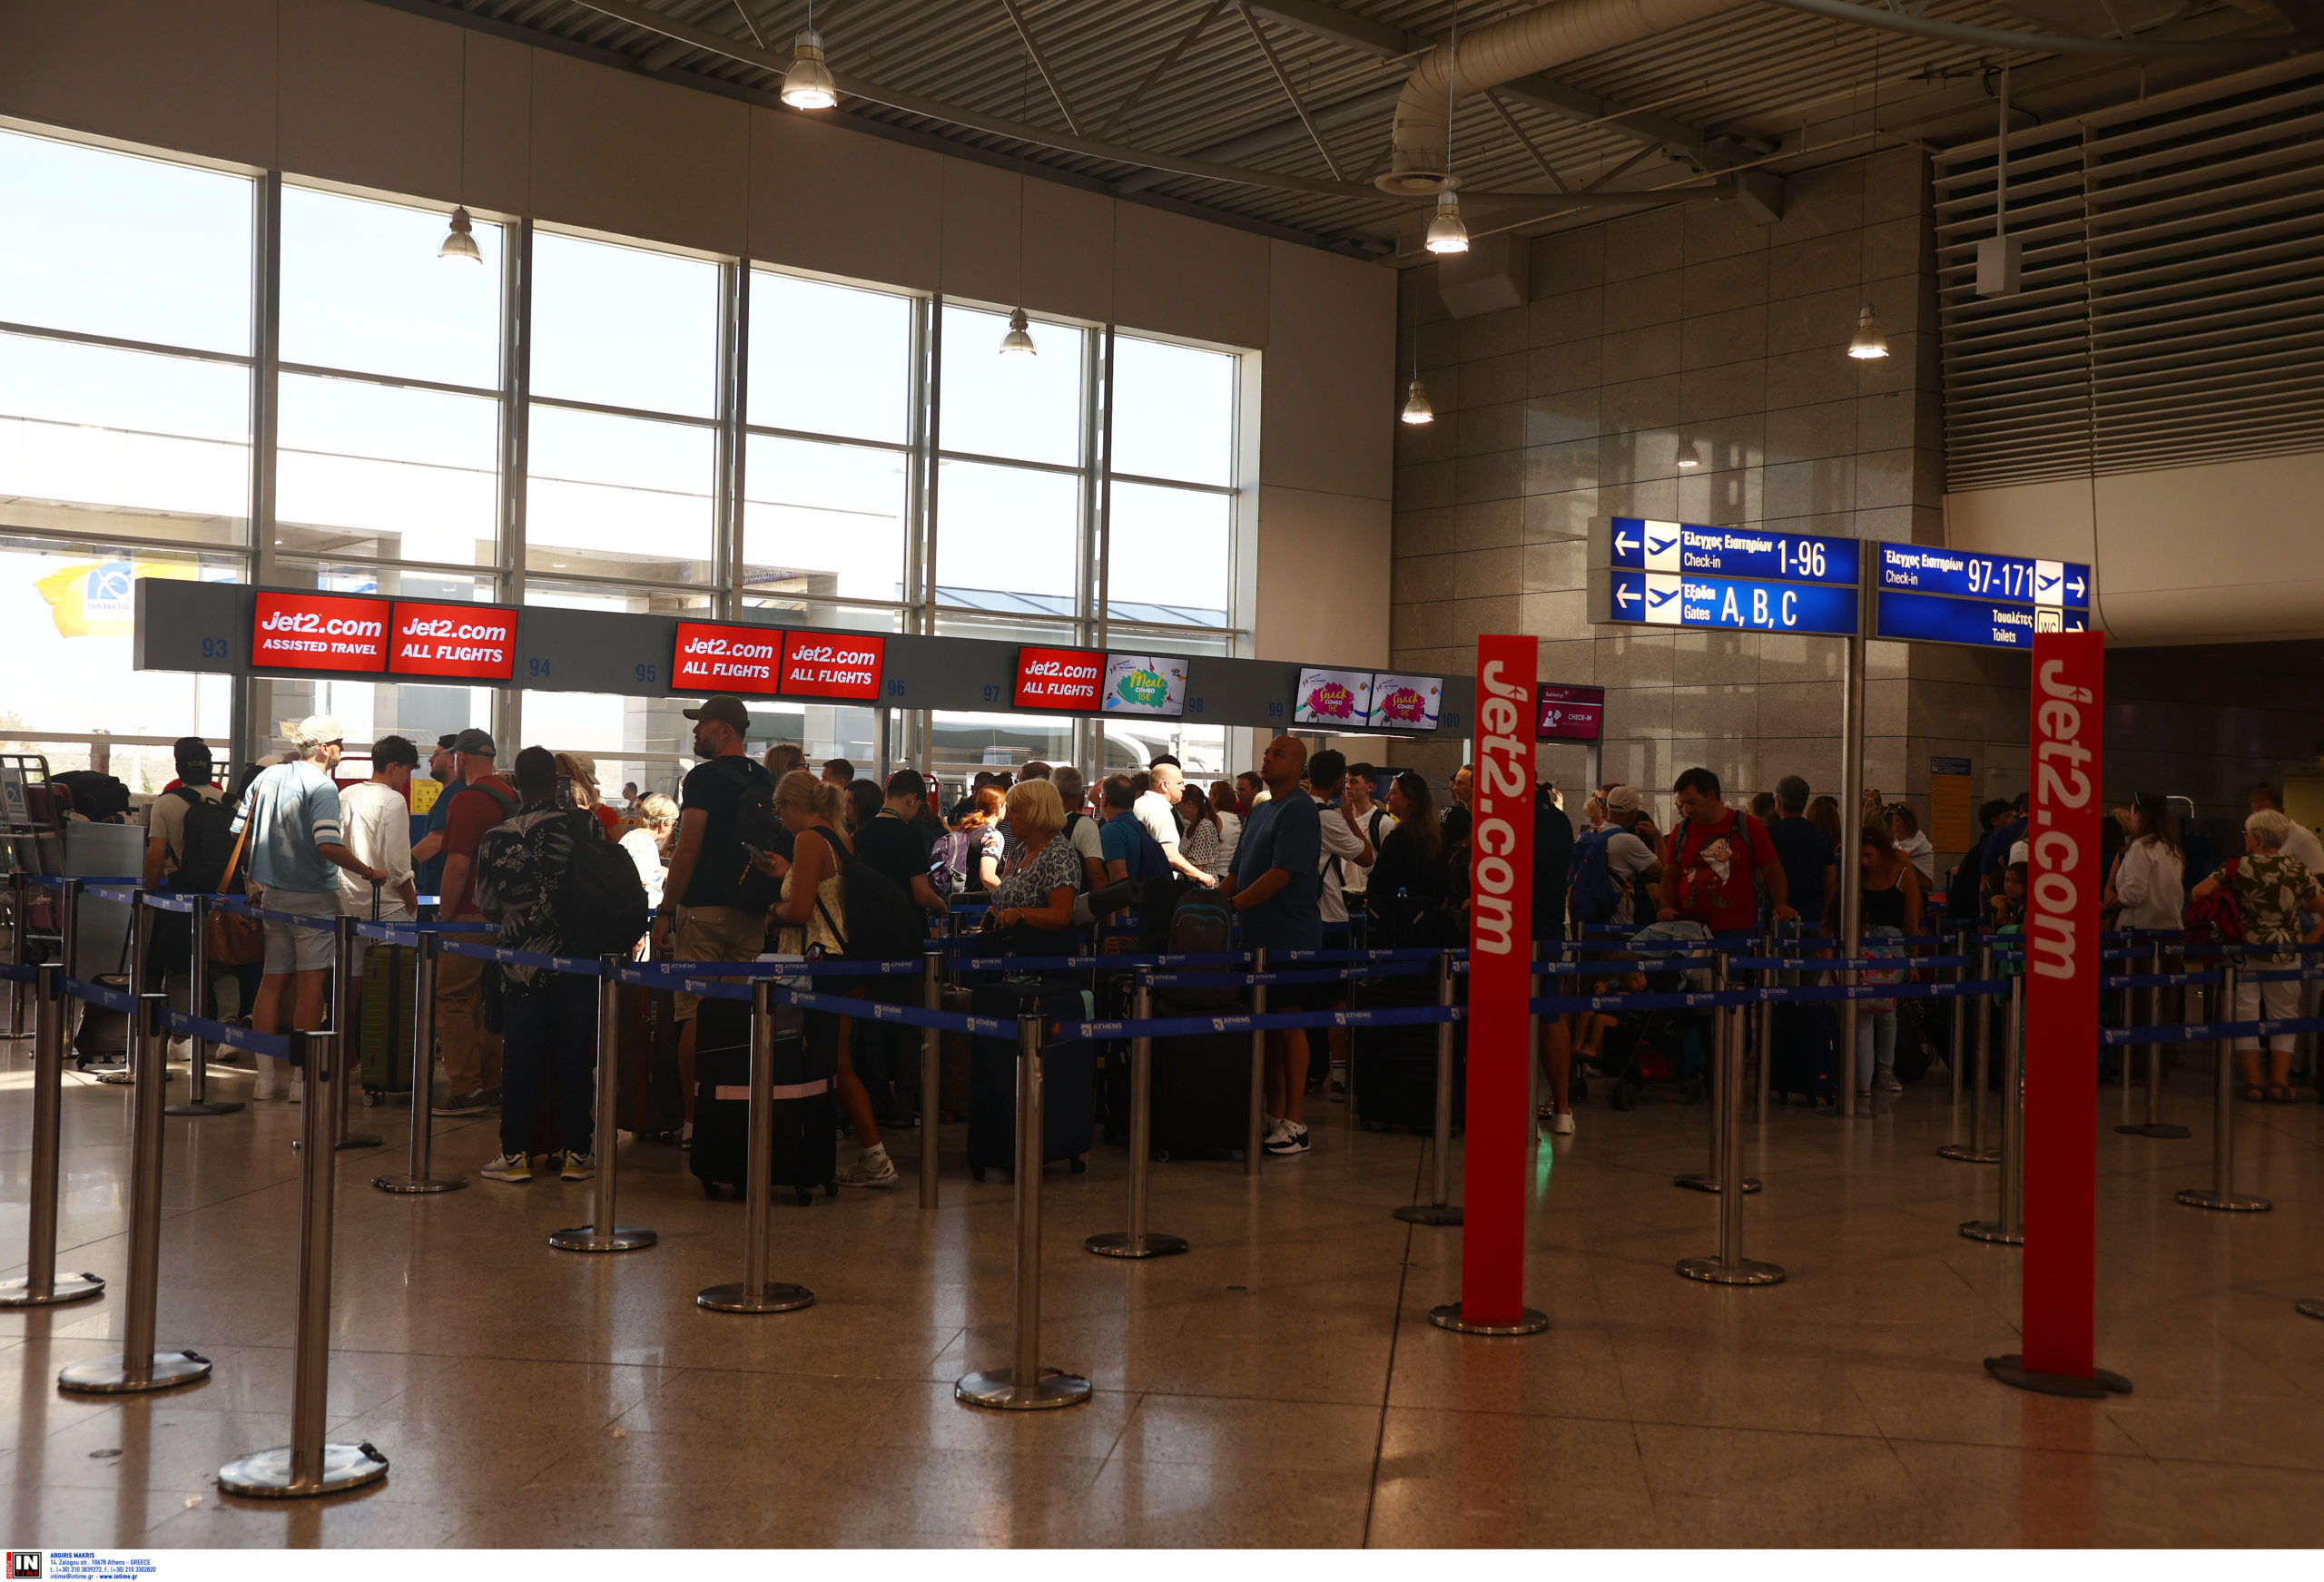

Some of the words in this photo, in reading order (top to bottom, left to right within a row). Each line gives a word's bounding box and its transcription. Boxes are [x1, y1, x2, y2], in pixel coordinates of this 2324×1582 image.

[1681, 530, 1723, 551] Έλεγχος
[1724, 534, 1773, 554] Εισιτηρίων
[1684, 552, 1721, 569] Check-in
[1777, 539, 1826, 577] 1-96
[1884, 549, 1920, 569] Έλεγχος
[1886, 570, 1918, 586] Check-in
[1968, 559, 2034, 598] 97-171
[1681, 583, 1716, 602] Έξοδοι
[1684, 604, 1711, 621] Gates
[1782, 590, 1797, 626] C
[261, 611, 382, 637] Jet2.com
[1993, 609, 2034, 628] Τουαλέτες
[402, 617, 507, 642] Jet2.com
[1992, 627, 2017, 644] Toilets
[202, 637, 228, 659] 93
[262, 638, 328, 653] ASSISTED
[330, 642, 377, 655] TRAVEL
[400, 644, 431, 659] ALL
[436, 645, 503, 663] FLIGHTS
[684, 637, 773, 659] Jet2.com
[792, 644, 875, 665] Jet2.com
[529, 657, 551, 677] 94
[635, 663, 656, 683] 95
[683, 661, 709, 675] ALL
[712, 663, 770, 679] FLIGHTS
[790, 668, 814, 682] ALL
[818, 669, 872, 684] FLIGHTS
[1025, 660, 1098, 680] Jet2.com
[888, 679, 906, 697] 96
[1129, 669, 1165, 688] Meal
[984, 684, 1000, 703] 97
[1023, 682, 1044, 694] ALL
[1047, 683, 1094, 697] FLIGHTS
[1138, 693, 1151, 701] 15€
[1319, 686, 1347, 702] Snack
[1393, 691, 1418, 706] Snack
[1188, 697, 1204, 713] 98
[1269, 703, 1284, 718] 99
[1328, 704, 1338, 712] 9€
[1443, 713, 1461, 728] 100
[1568, 713, 1592, 722] CHECK-IN
[1476, 660, 1529, 955] Jet2.com
[2034, 659, 2093, 980] Jet2.com
[1092, 1022, 1123, 1030] ATHENS
[1223, 1016, 1251, 1024] ATHENS
